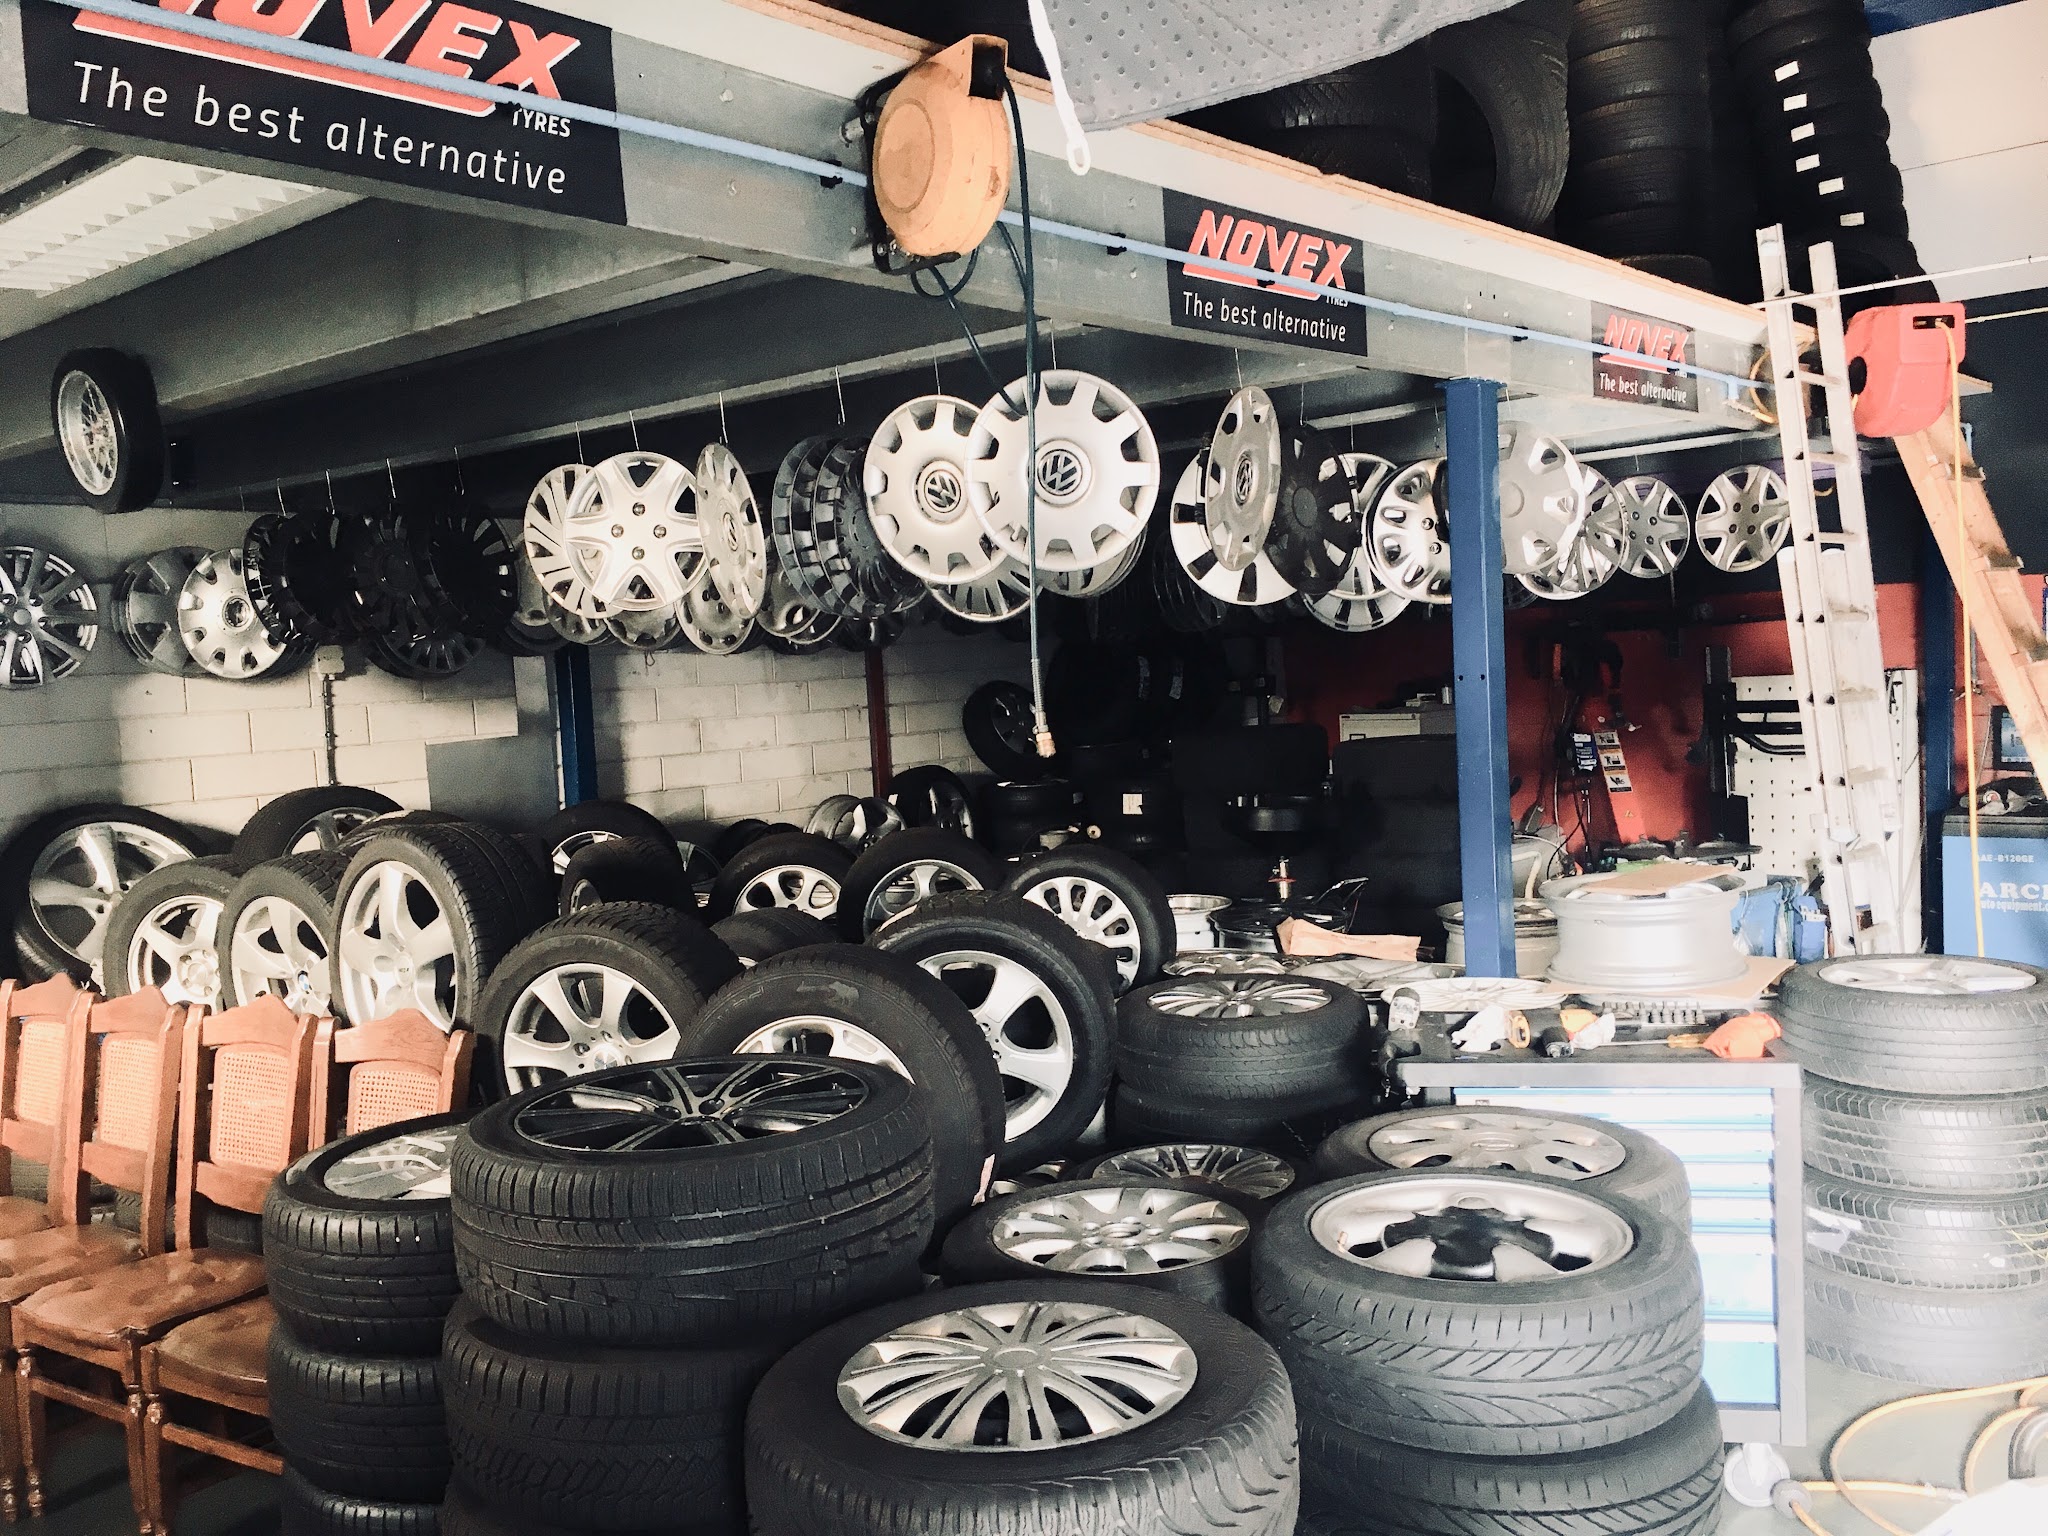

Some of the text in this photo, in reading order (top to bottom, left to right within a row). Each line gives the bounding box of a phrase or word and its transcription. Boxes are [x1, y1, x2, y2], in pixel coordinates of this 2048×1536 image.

[73, 60, 567, 194] The best alternative
[513, 108, 571, 137] TYRES
[1186, 209, 1352, 289] NOVEX
[1183, 291, 1346, 342] The best alternative
[1603, 314, 1690, 365] NOVEX
[1600, 373, 1687, 403] The best alternative
